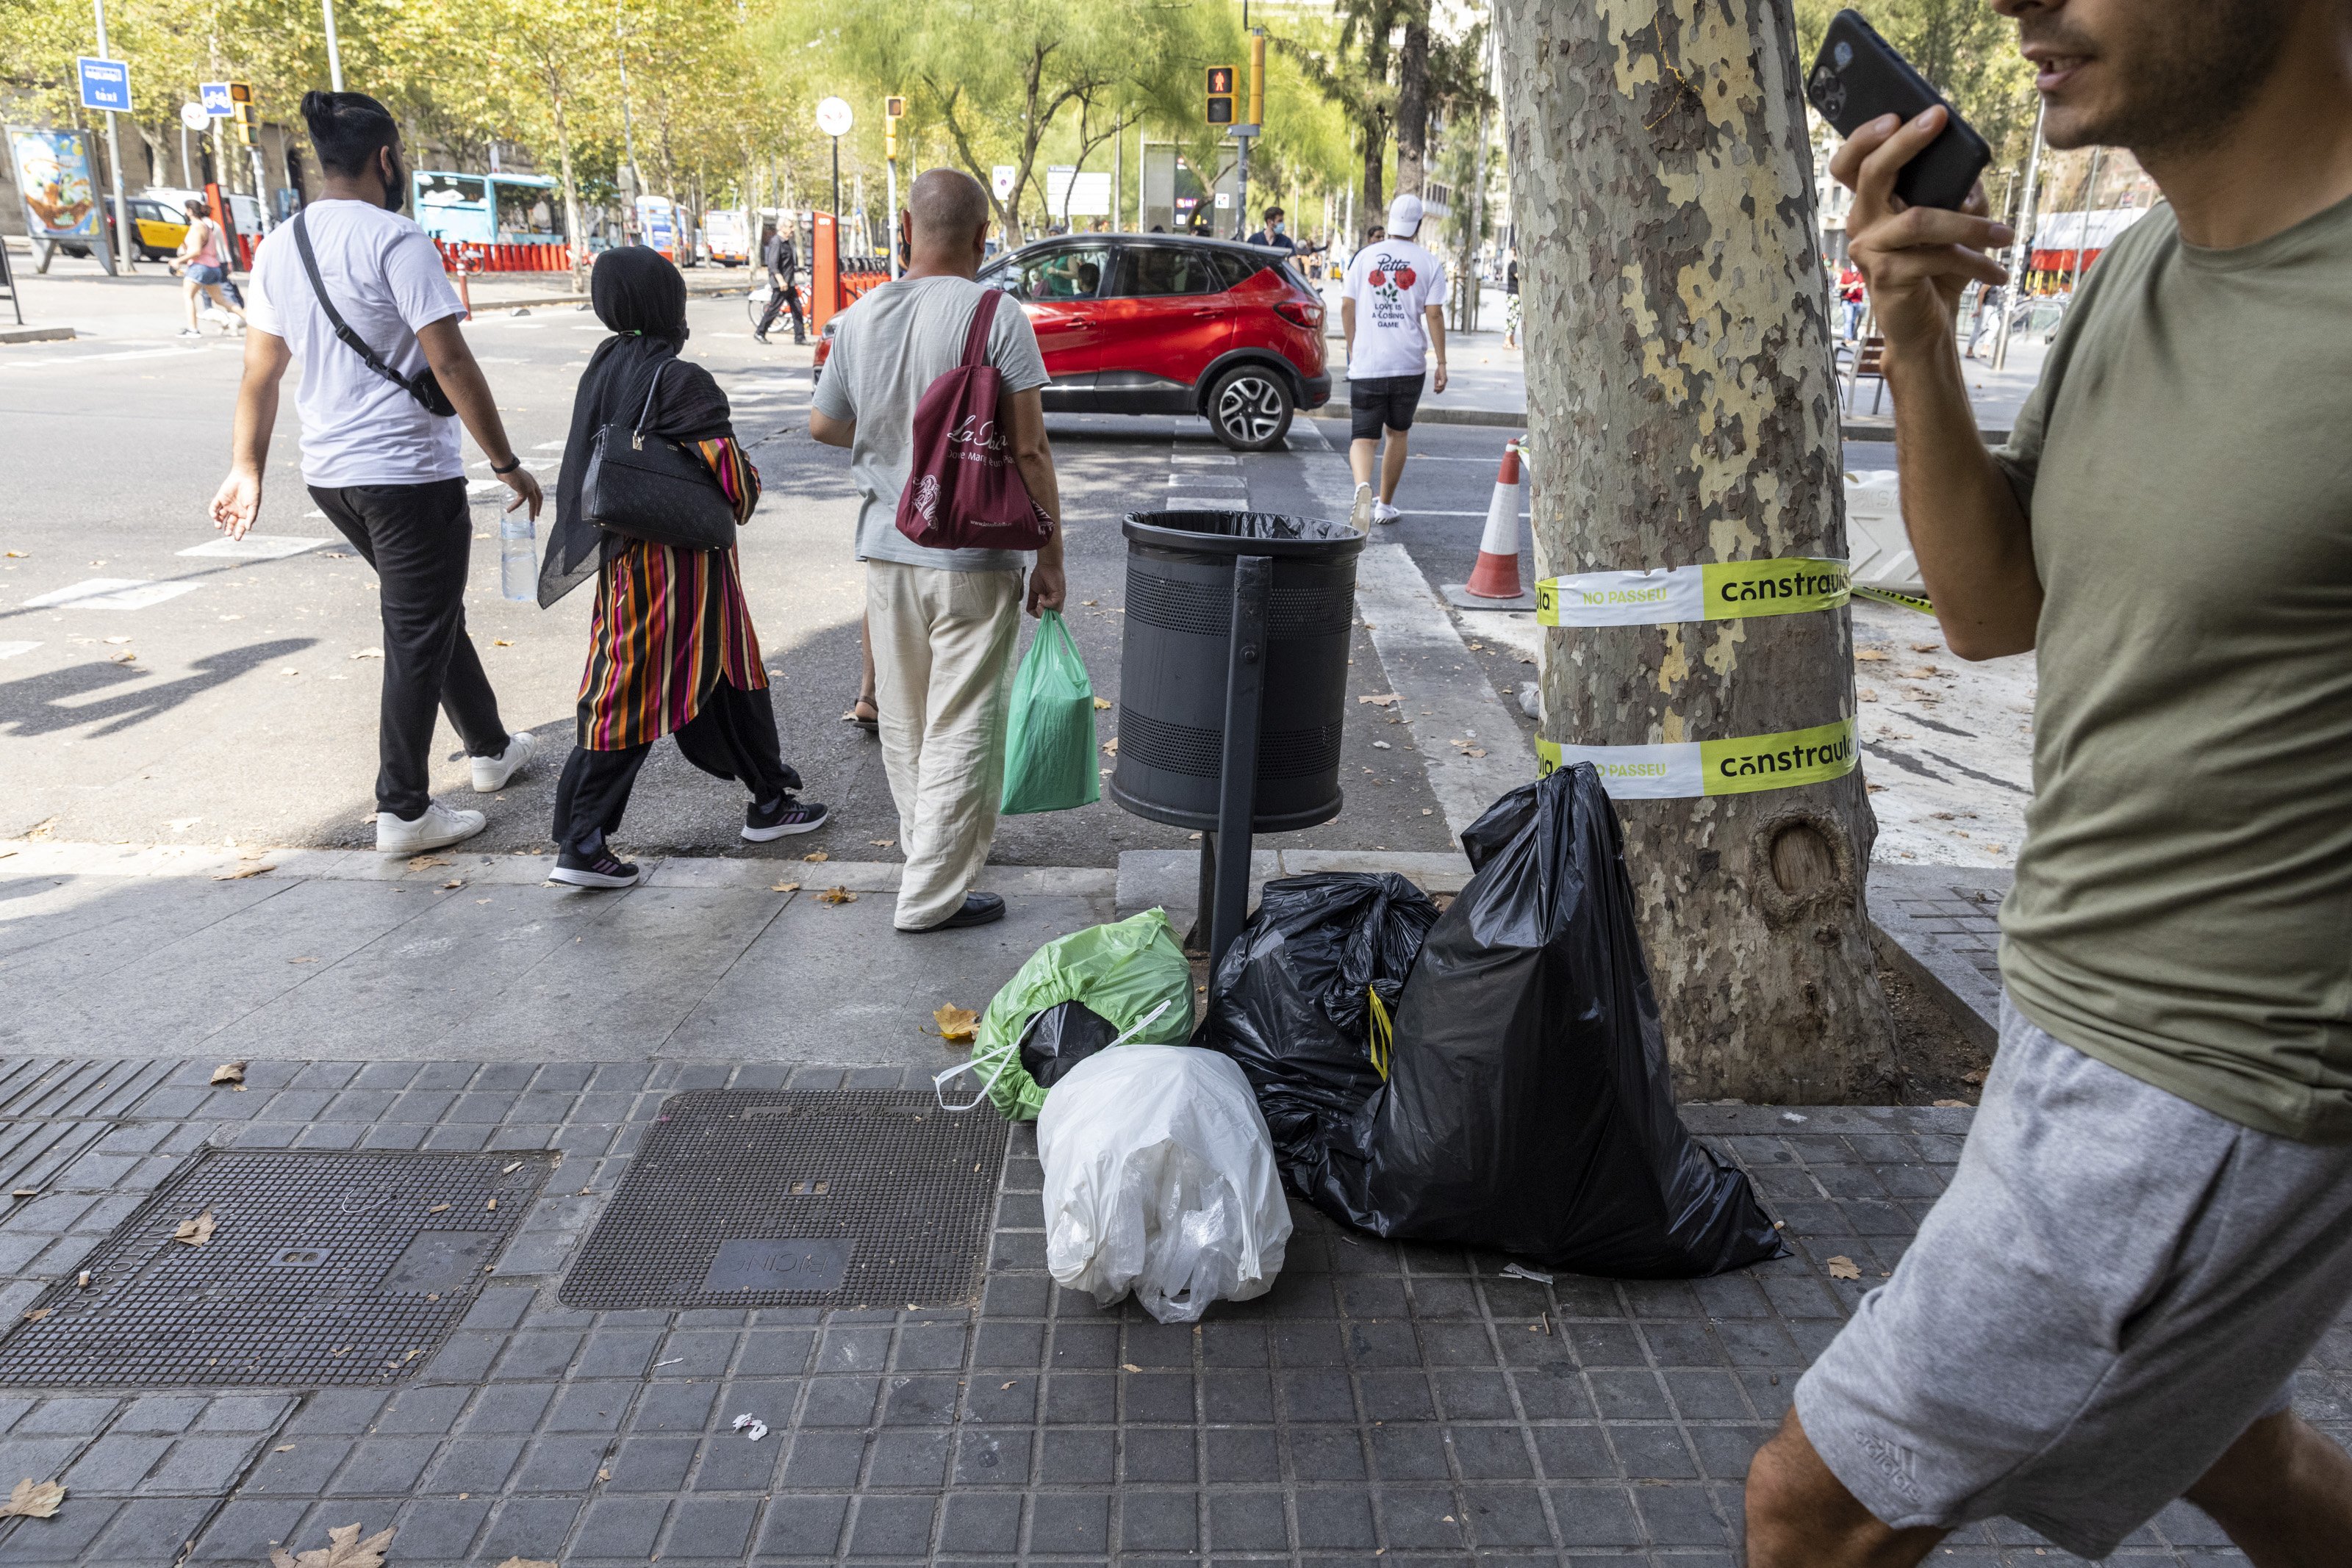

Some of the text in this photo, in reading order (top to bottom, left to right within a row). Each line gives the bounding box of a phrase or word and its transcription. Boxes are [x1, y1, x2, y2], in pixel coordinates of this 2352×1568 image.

[1376, 253, 1410, 276] Patta
[947, 414, 976, 442] La
[1583, 588, 1667, 605] NO PASSEU
[1610, 763, 1666, 777] PASSEU
[1853, 1429, 1921, 1503] adidas
